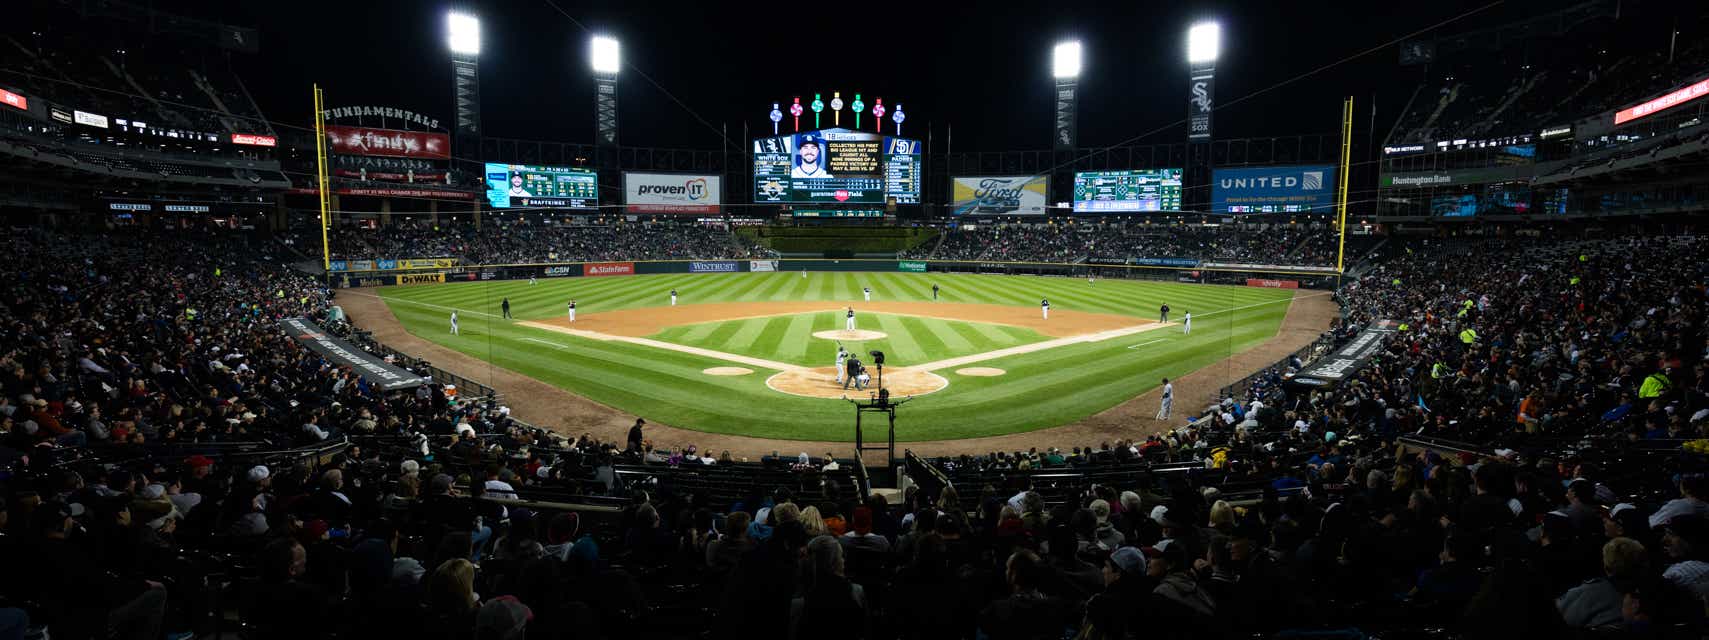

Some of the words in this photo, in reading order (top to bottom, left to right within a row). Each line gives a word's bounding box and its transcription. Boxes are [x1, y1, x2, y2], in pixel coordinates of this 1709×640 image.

[323, 106, 439, 129] FUNDAMENTALS
[1221, 177, 1297, 189] UNITED
[1392, 176, 1433, 185] Huntington
[1433, 175, 1451, 183] Bank
[638, 184, 685, 195] proven
[692, 184, 703, 195] IT
[974, 178, 1025, 200] Ford
[693, 262, 734, 272] WINTRUST
